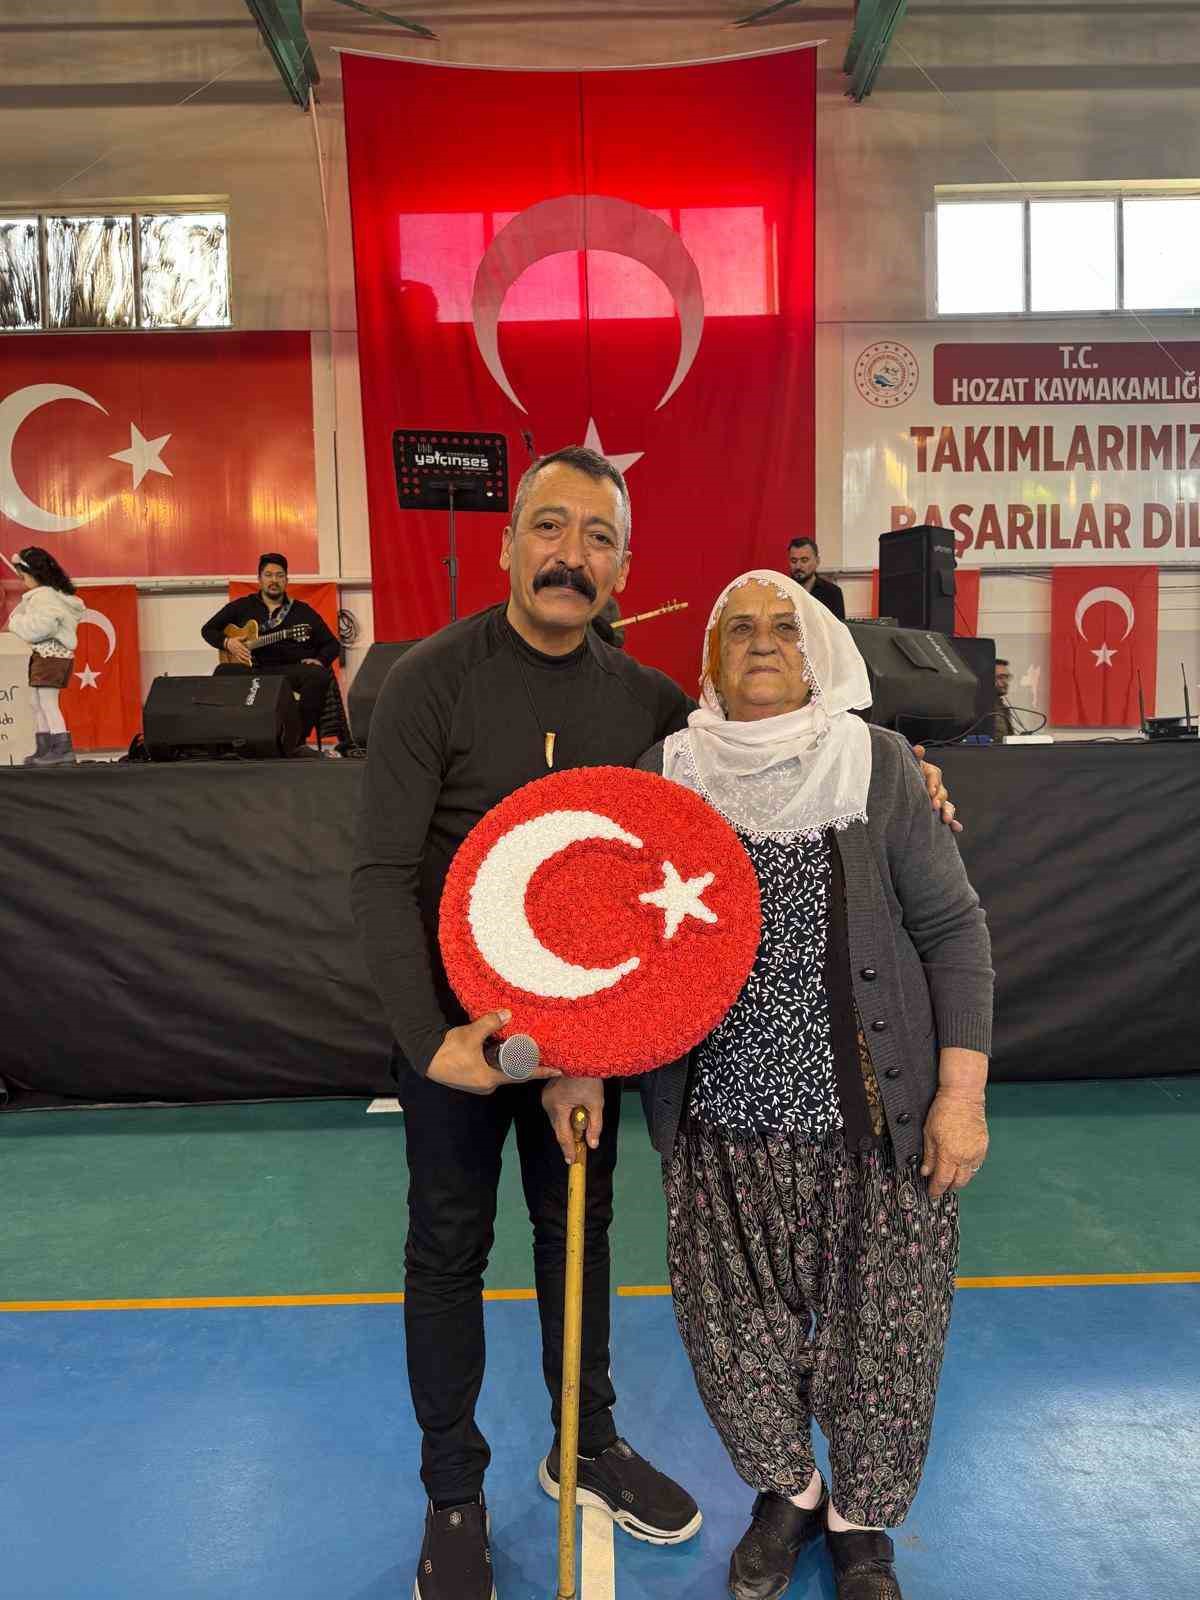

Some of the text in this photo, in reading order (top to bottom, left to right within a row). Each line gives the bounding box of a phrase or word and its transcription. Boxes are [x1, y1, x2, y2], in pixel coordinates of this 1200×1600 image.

[1059, 345, 1099, 369] T.C.
[952, 371, 1200, 402] HOZAT KAYMAKAMLIĞ
